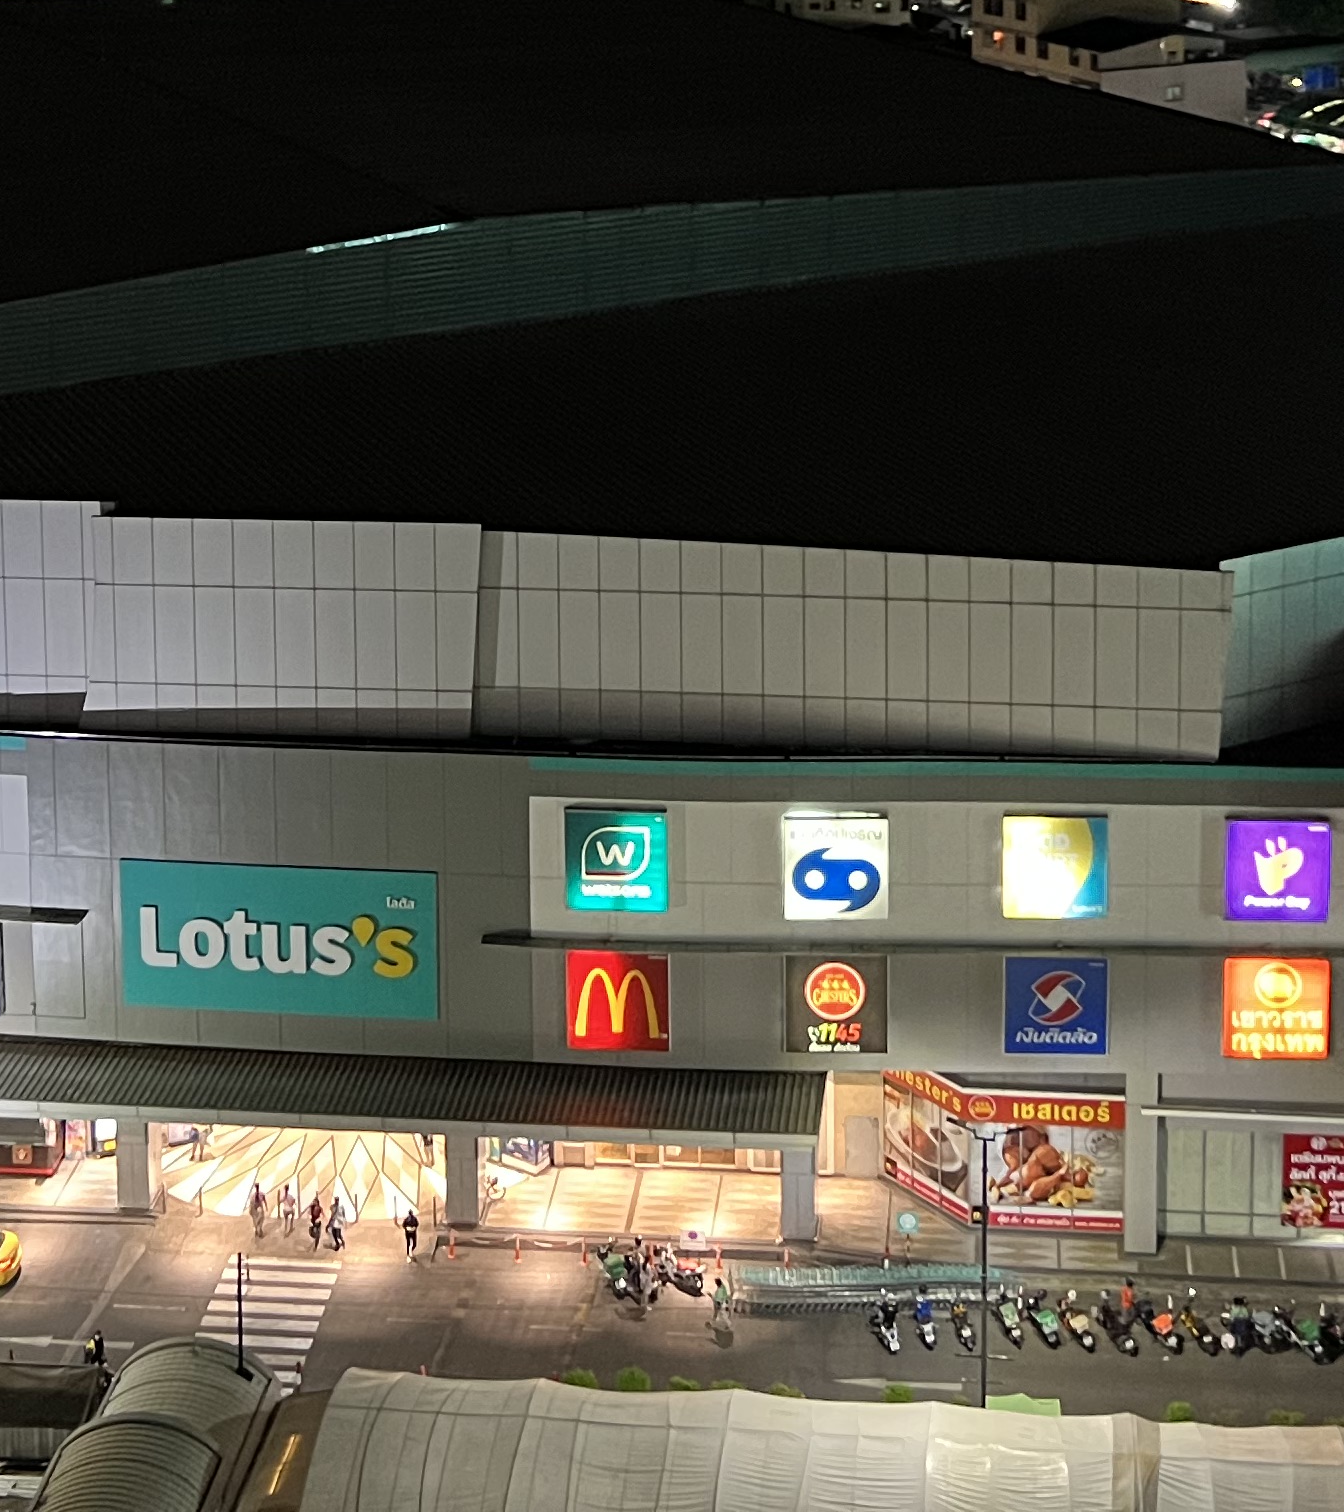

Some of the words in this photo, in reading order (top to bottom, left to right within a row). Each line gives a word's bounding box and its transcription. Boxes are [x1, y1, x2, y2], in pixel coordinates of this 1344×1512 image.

[139, 905, 415, 979] Lotus's
[1231, 1009, 1324, 1029] เยาวราช
[818, 1022, 862, 1043] 1145
[1016, 1027, 1098, 1045] เงินติดล้อ
[1231, 1032, 1325, 1060] กรุงเทพ
[1012, 1100, 1111, 1124] เชสเตอร์
